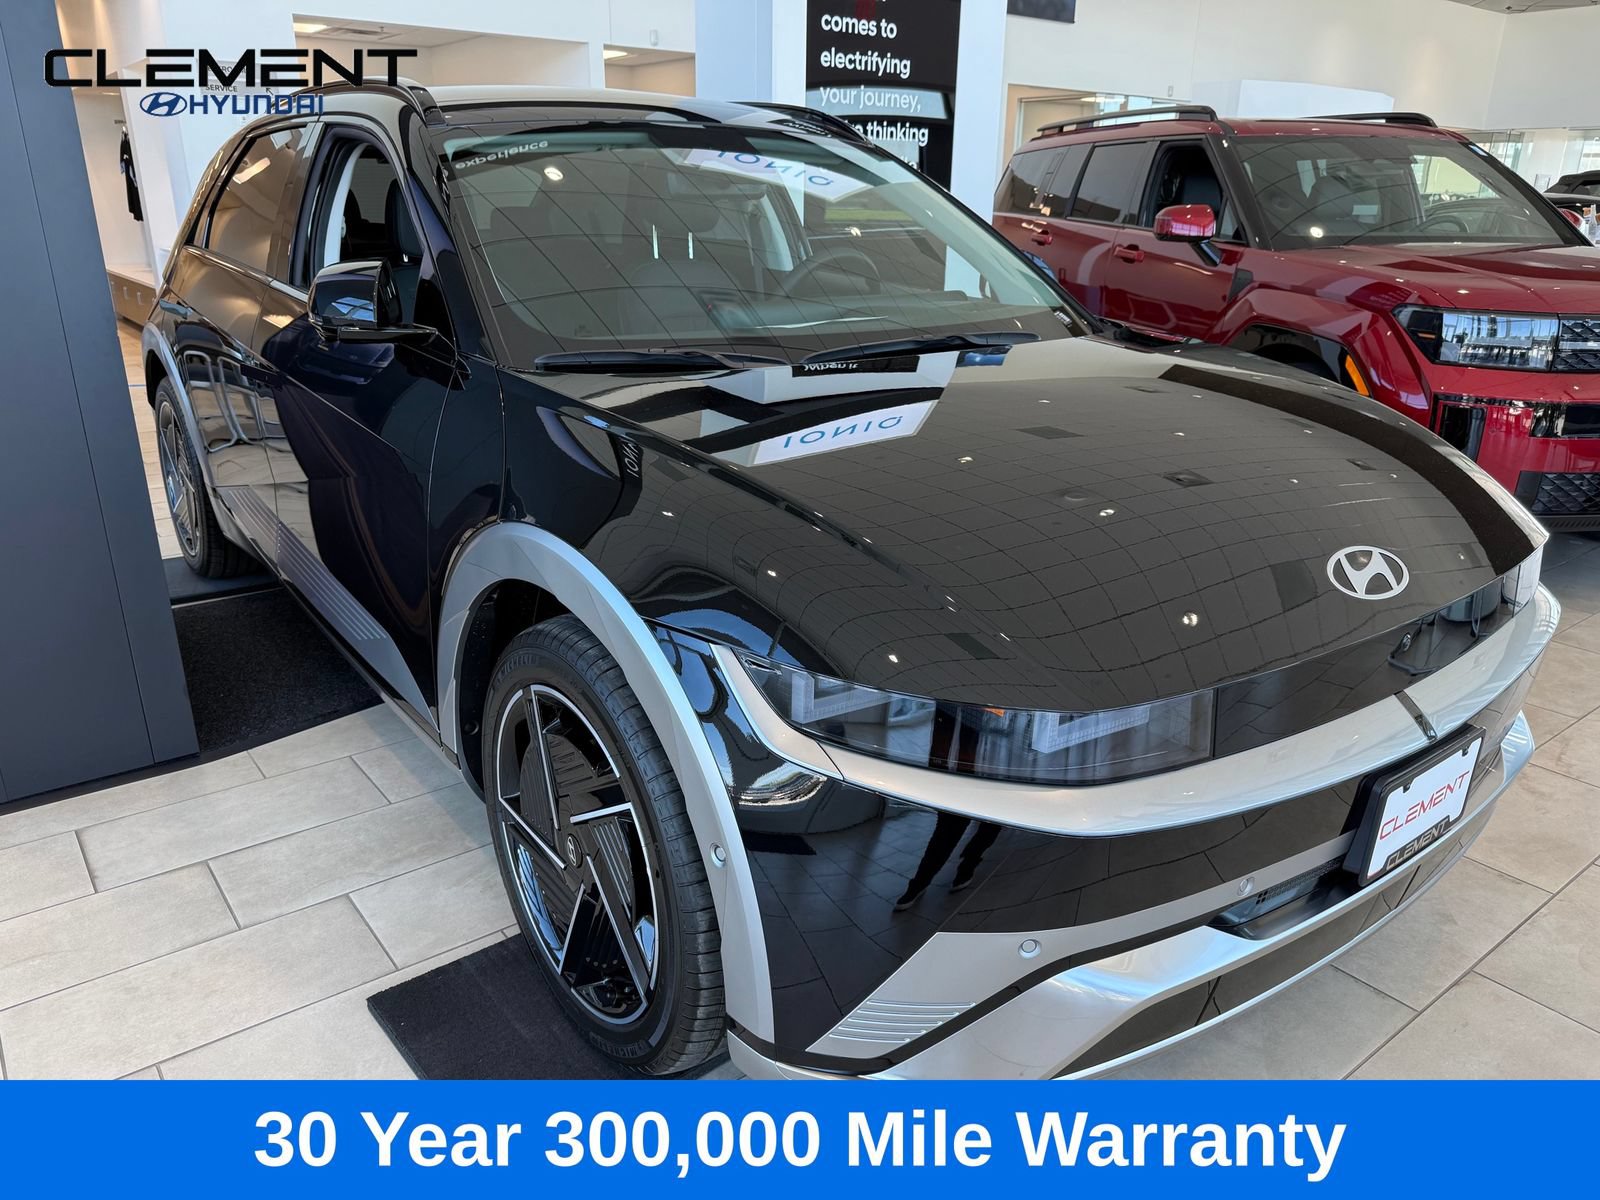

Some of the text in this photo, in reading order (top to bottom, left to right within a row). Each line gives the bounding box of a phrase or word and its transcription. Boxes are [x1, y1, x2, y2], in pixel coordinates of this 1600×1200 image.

[820, 13, 898, 39] comes to
[820, 46, 911, 79] electrifying
[819, 84, 921, 113] your journey,
[866, 120, 929, 147] thinking
[1380, 770, 1470, 841] CLEMENT
[1385, 820, 1447, 871] CLEMENT
